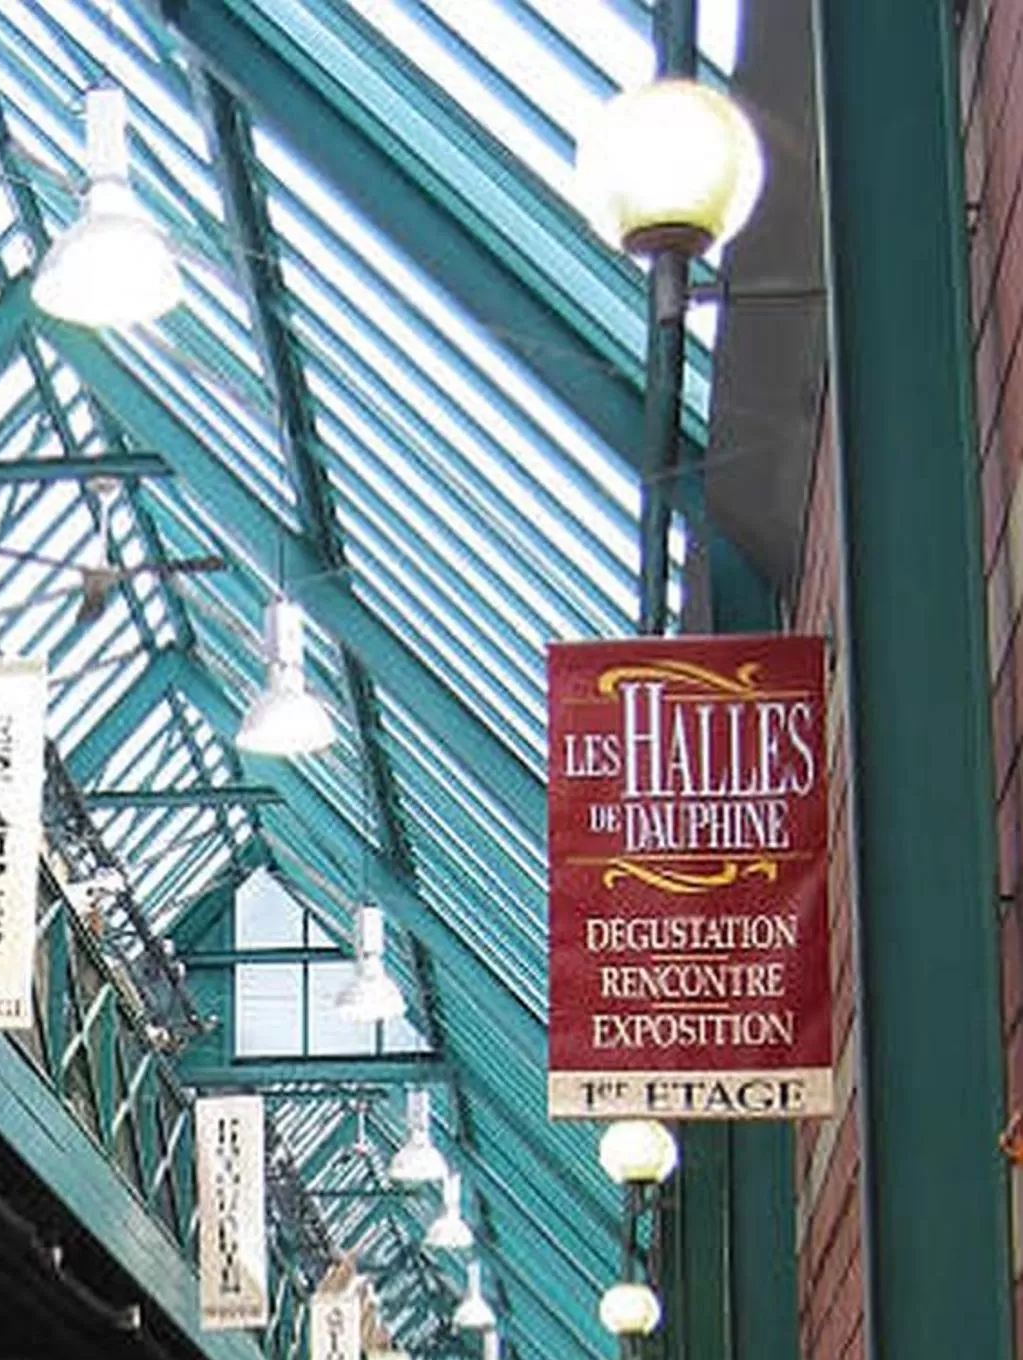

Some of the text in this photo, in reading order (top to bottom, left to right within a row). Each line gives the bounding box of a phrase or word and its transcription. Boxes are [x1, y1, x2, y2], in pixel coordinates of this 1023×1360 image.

[564, 682, 815, 798] LES HALLES
[589, 800, 790, 852] DE DAUPHINE
[587, 915, 798, 952] DEGUSTATION
[600, 963, 786, 1000] RENCONTRE
[592, 1011, 795, 1049] EXPOSITION
[645, 1078, 805, 1111] ETAGE
